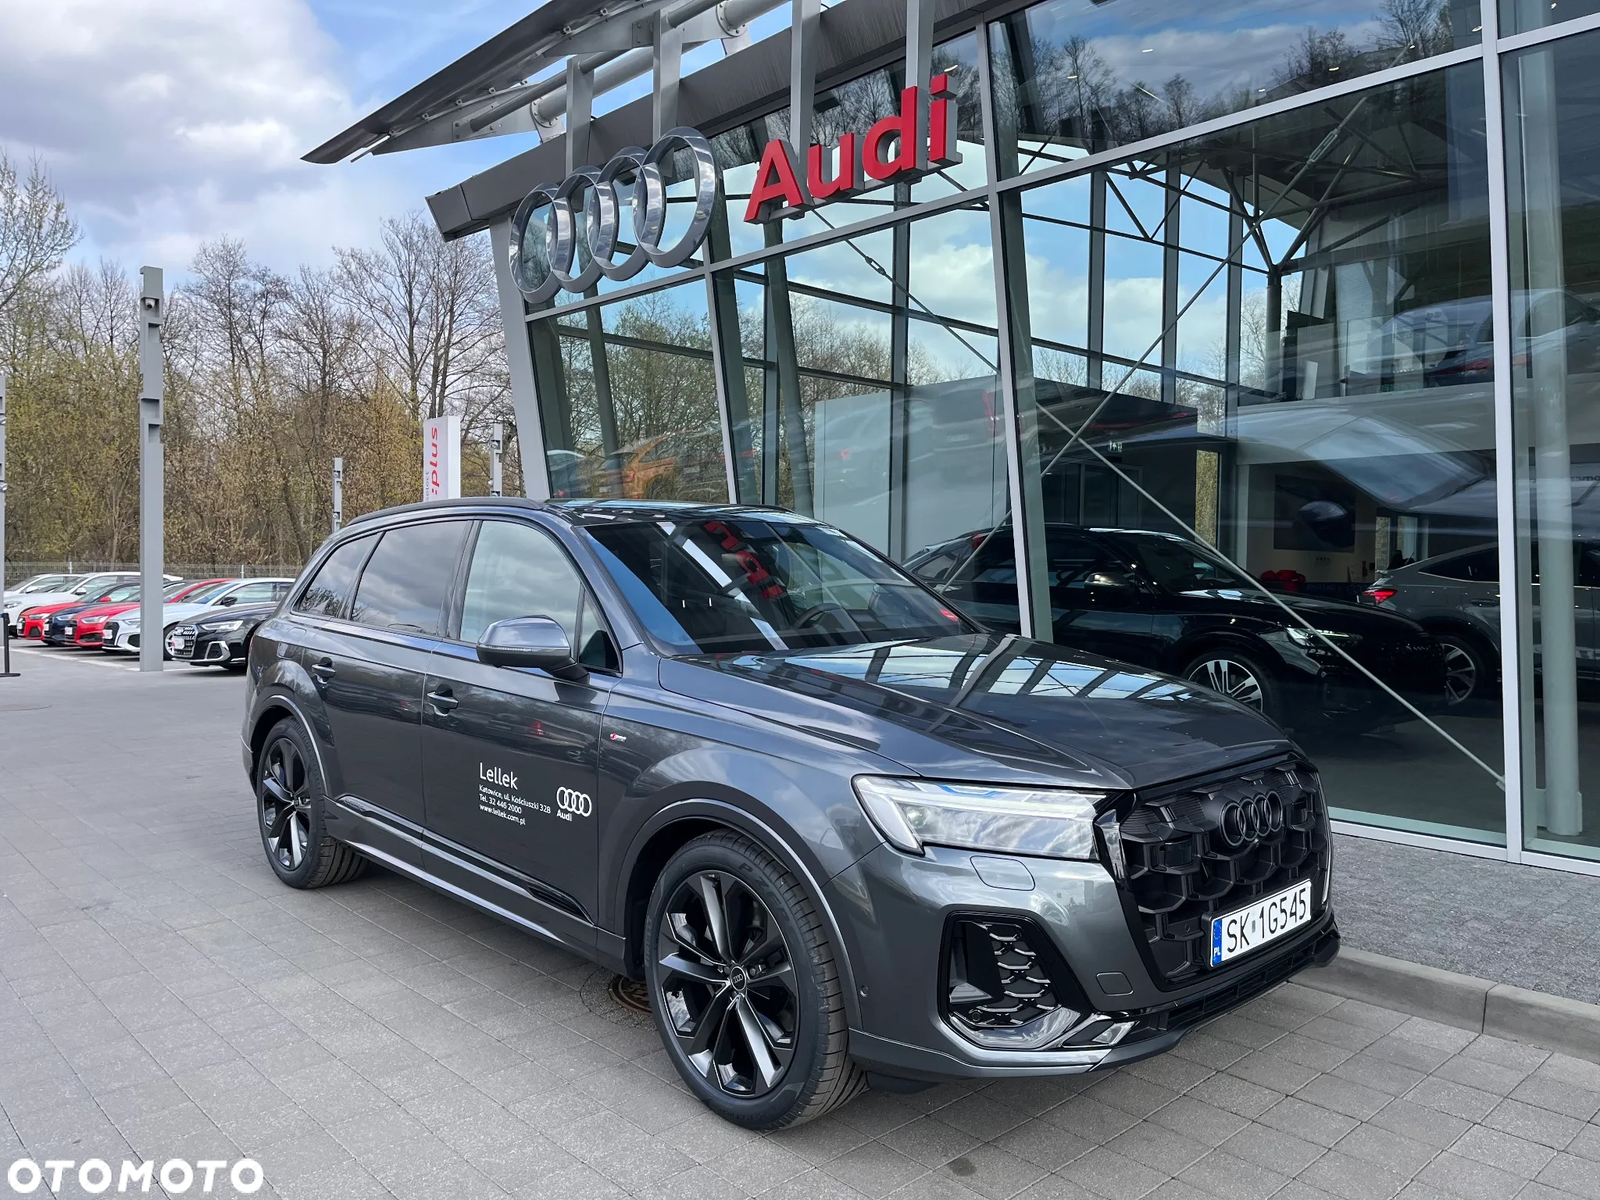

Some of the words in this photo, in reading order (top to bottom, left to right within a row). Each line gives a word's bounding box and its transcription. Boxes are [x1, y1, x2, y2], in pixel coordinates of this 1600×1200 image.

[744, 74, 956, 223] Audi
[479, 761, 518, 790] Lellek
[479, 784, 503, 800] Katowice,
[539, 803, 552, 814] 328
[479, 793, 488, 803] Tel.
[488, 796, 496, 806] 32
[507, 803, 523, 814] 2000
[479, 804, 526, 826] www.lellek.com.pl
[556, 809, 573, 822] Audi
[1226, 911, 1251, 953] SK
[1258, 887, 1307, 939] 1G545
[1213, 947, 1222, 957] PL
